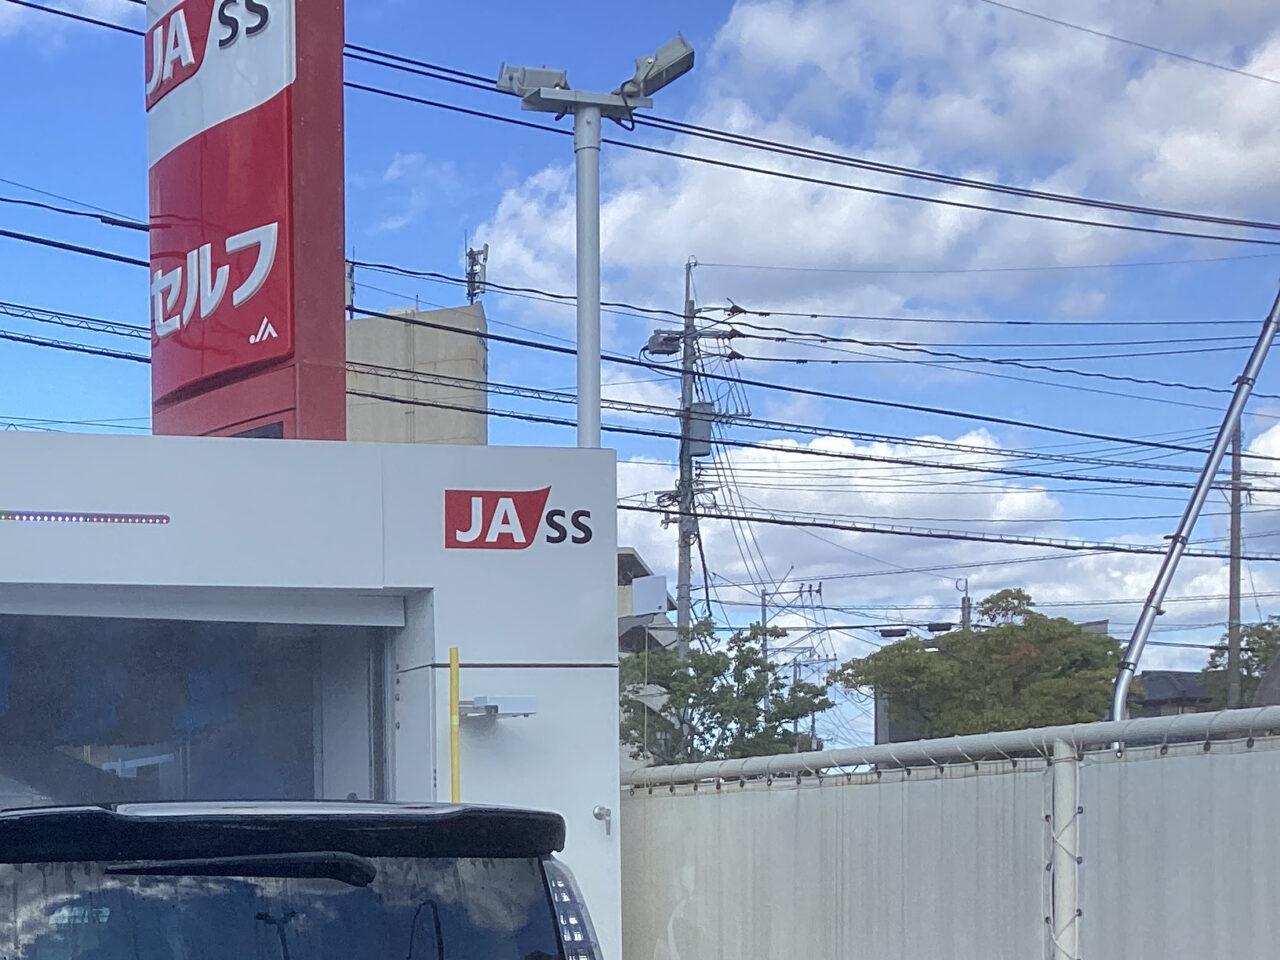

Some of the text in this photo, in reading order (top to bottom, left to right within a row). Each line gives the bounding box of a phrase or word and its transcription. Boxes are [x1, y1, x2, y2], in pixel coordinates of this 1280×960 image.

[146, 8, 196, 96] JA
[150, 222, 278, 339] セルフ
[455, 496, 593, 544] JA SS
